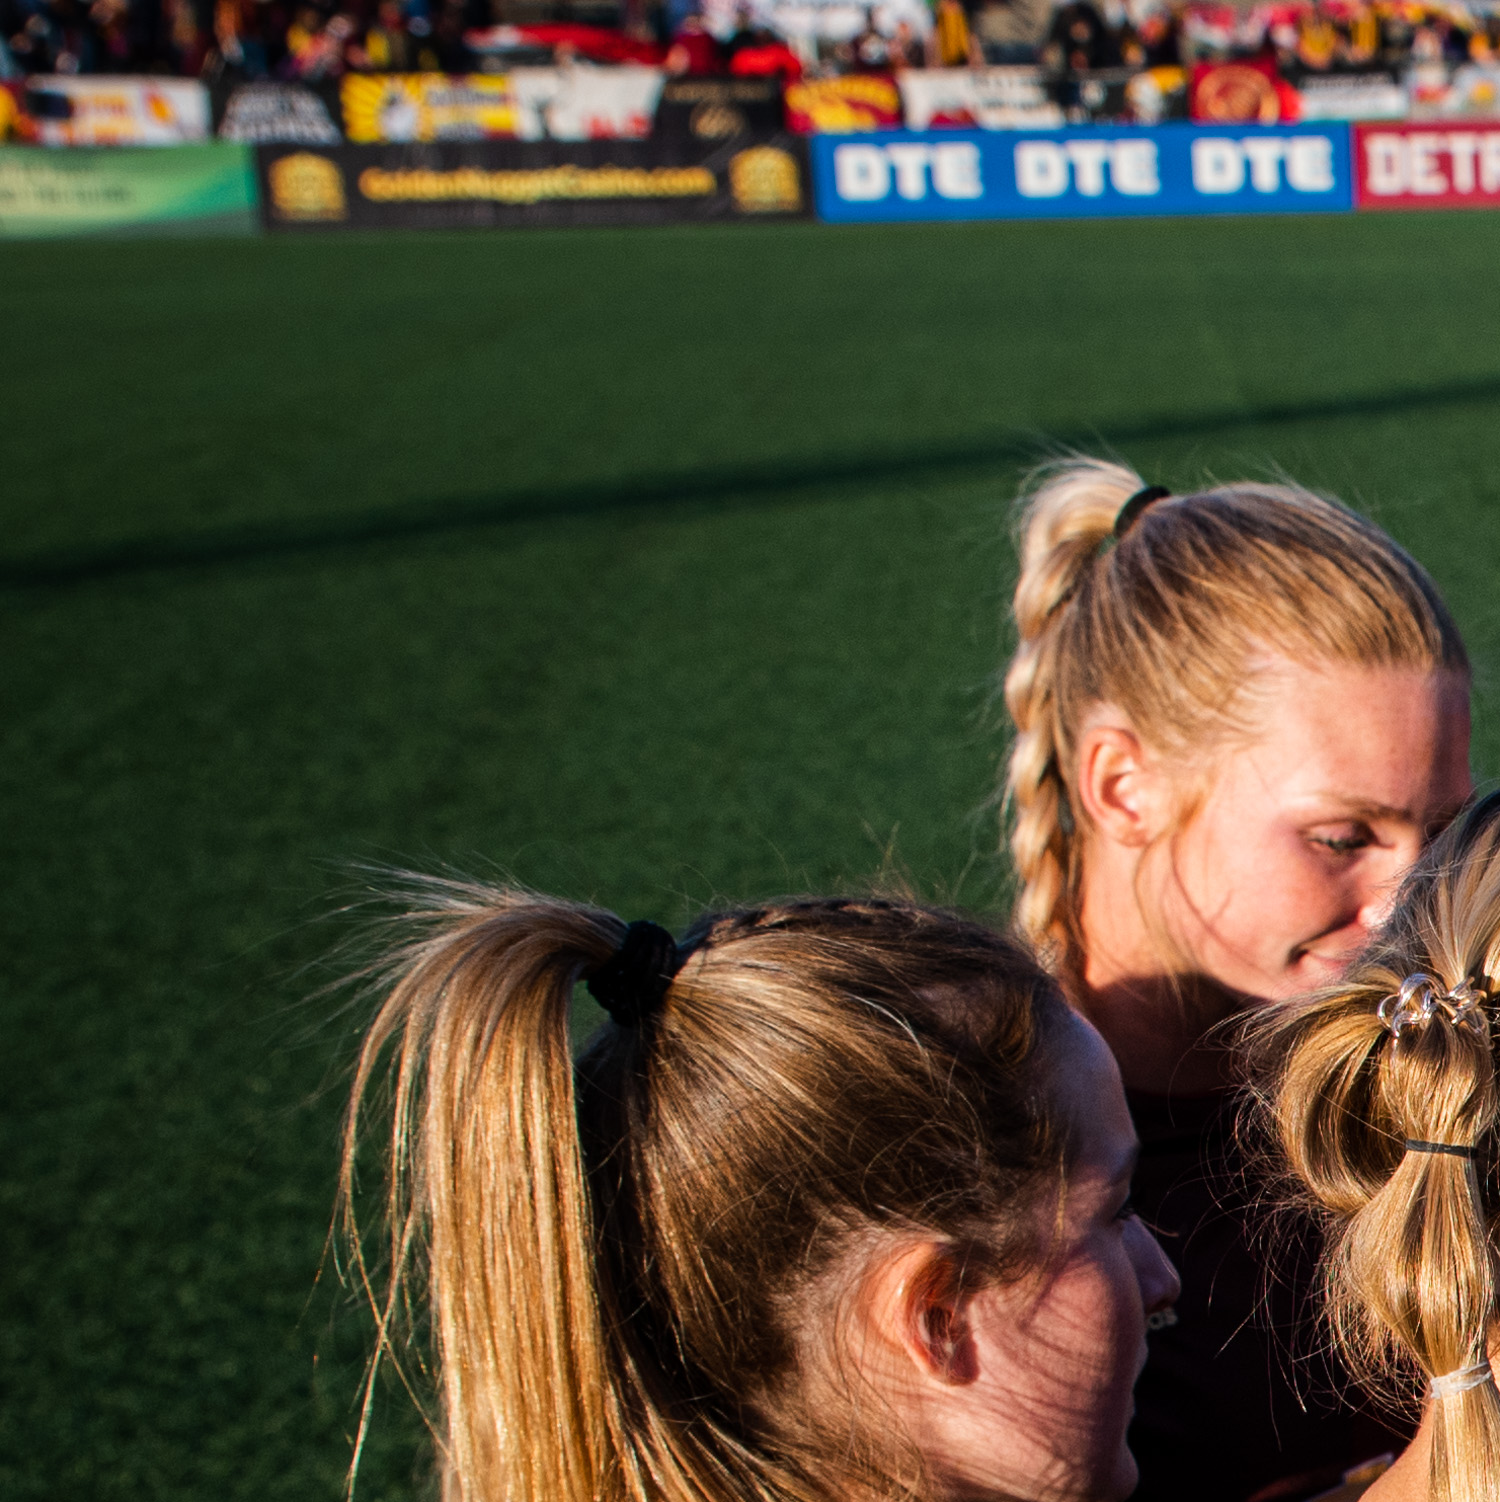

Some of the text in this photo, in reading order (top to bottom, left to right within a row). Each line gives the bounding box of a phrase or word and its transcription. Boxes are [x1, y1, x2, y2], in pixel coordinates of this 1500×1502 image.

[834, 141, 983, 201] DTE
[1014, 138, 1161, 198] DTE
[1192, 135, 1335, 194] DTE
